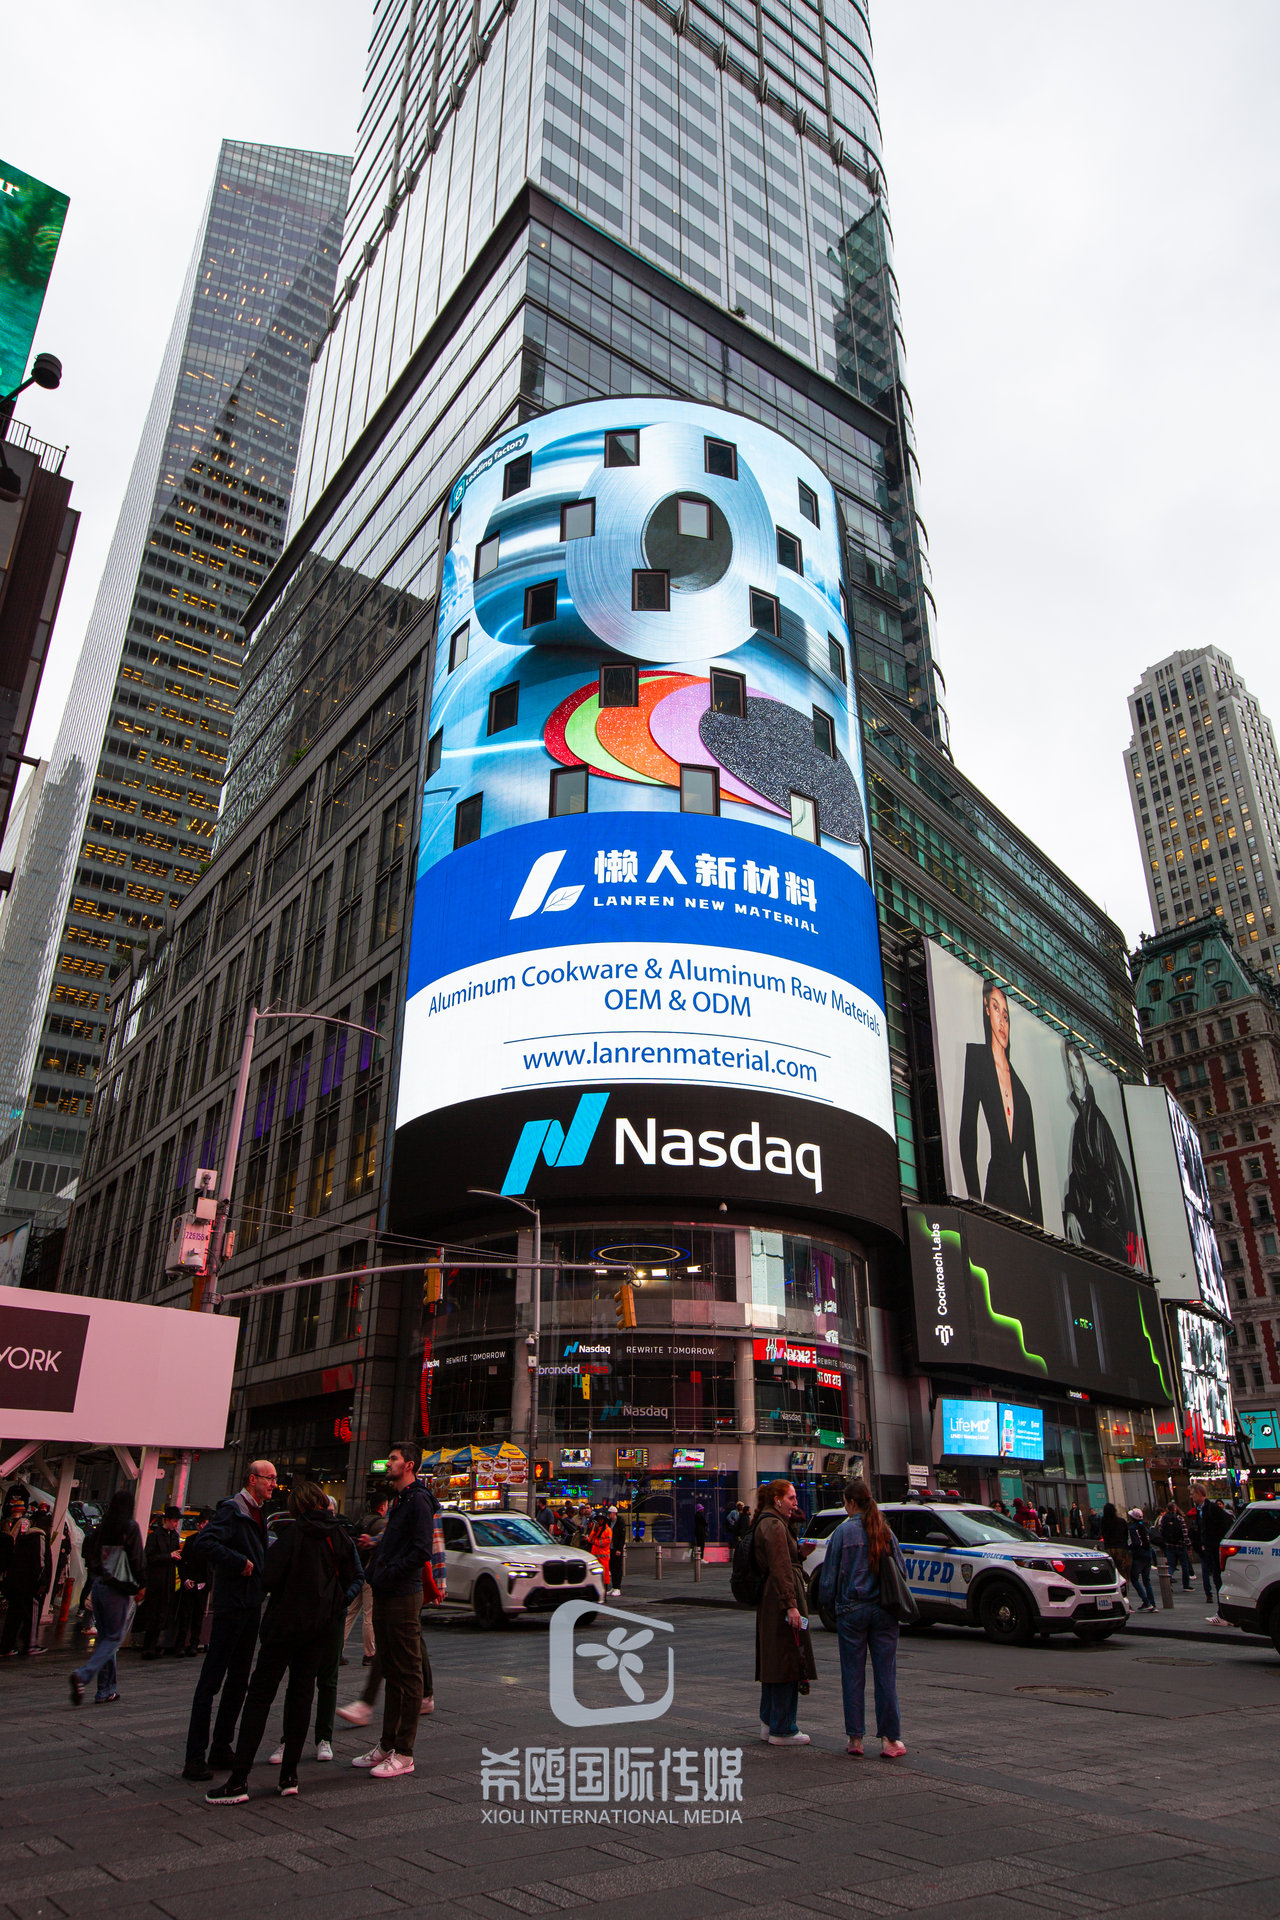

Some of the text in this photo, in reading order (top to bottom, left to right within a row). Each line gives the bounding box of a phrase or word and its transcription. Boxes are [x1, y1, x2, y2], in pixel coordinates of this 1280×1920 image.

[465, 437, 525, 486] Leading factory
[594, 849, 818, 912] 懒人新材料
[594, 895, 819, 935] LANREN NEW MATERIAL
[428, 958, 881, 1037] Aluminum Cookware & Aluminum Raw Materials
[604, 988, 751, 1018] OEM & ODM
[523, 1041, 817, 1083] www.lanrenmaterial.com
[615, 1117, 823, 1195] Nasdaq
[931, 1223, 948, 1316] Cockroach Labs
[446, 1354, 468, 1365] REWRITE
[470, 1351, 506, 1361] TOMORROW
[579, 1344, 716, 1355] Nasdaq REWRITE TOMORROW
[623, 1405, 669, 1420] Nasdaq
[950, 1417, 988, 1433] LifeMD
[905, 1558, 955, 1584] NYPD
[981, 1551, 1005, 1560] POLICE
